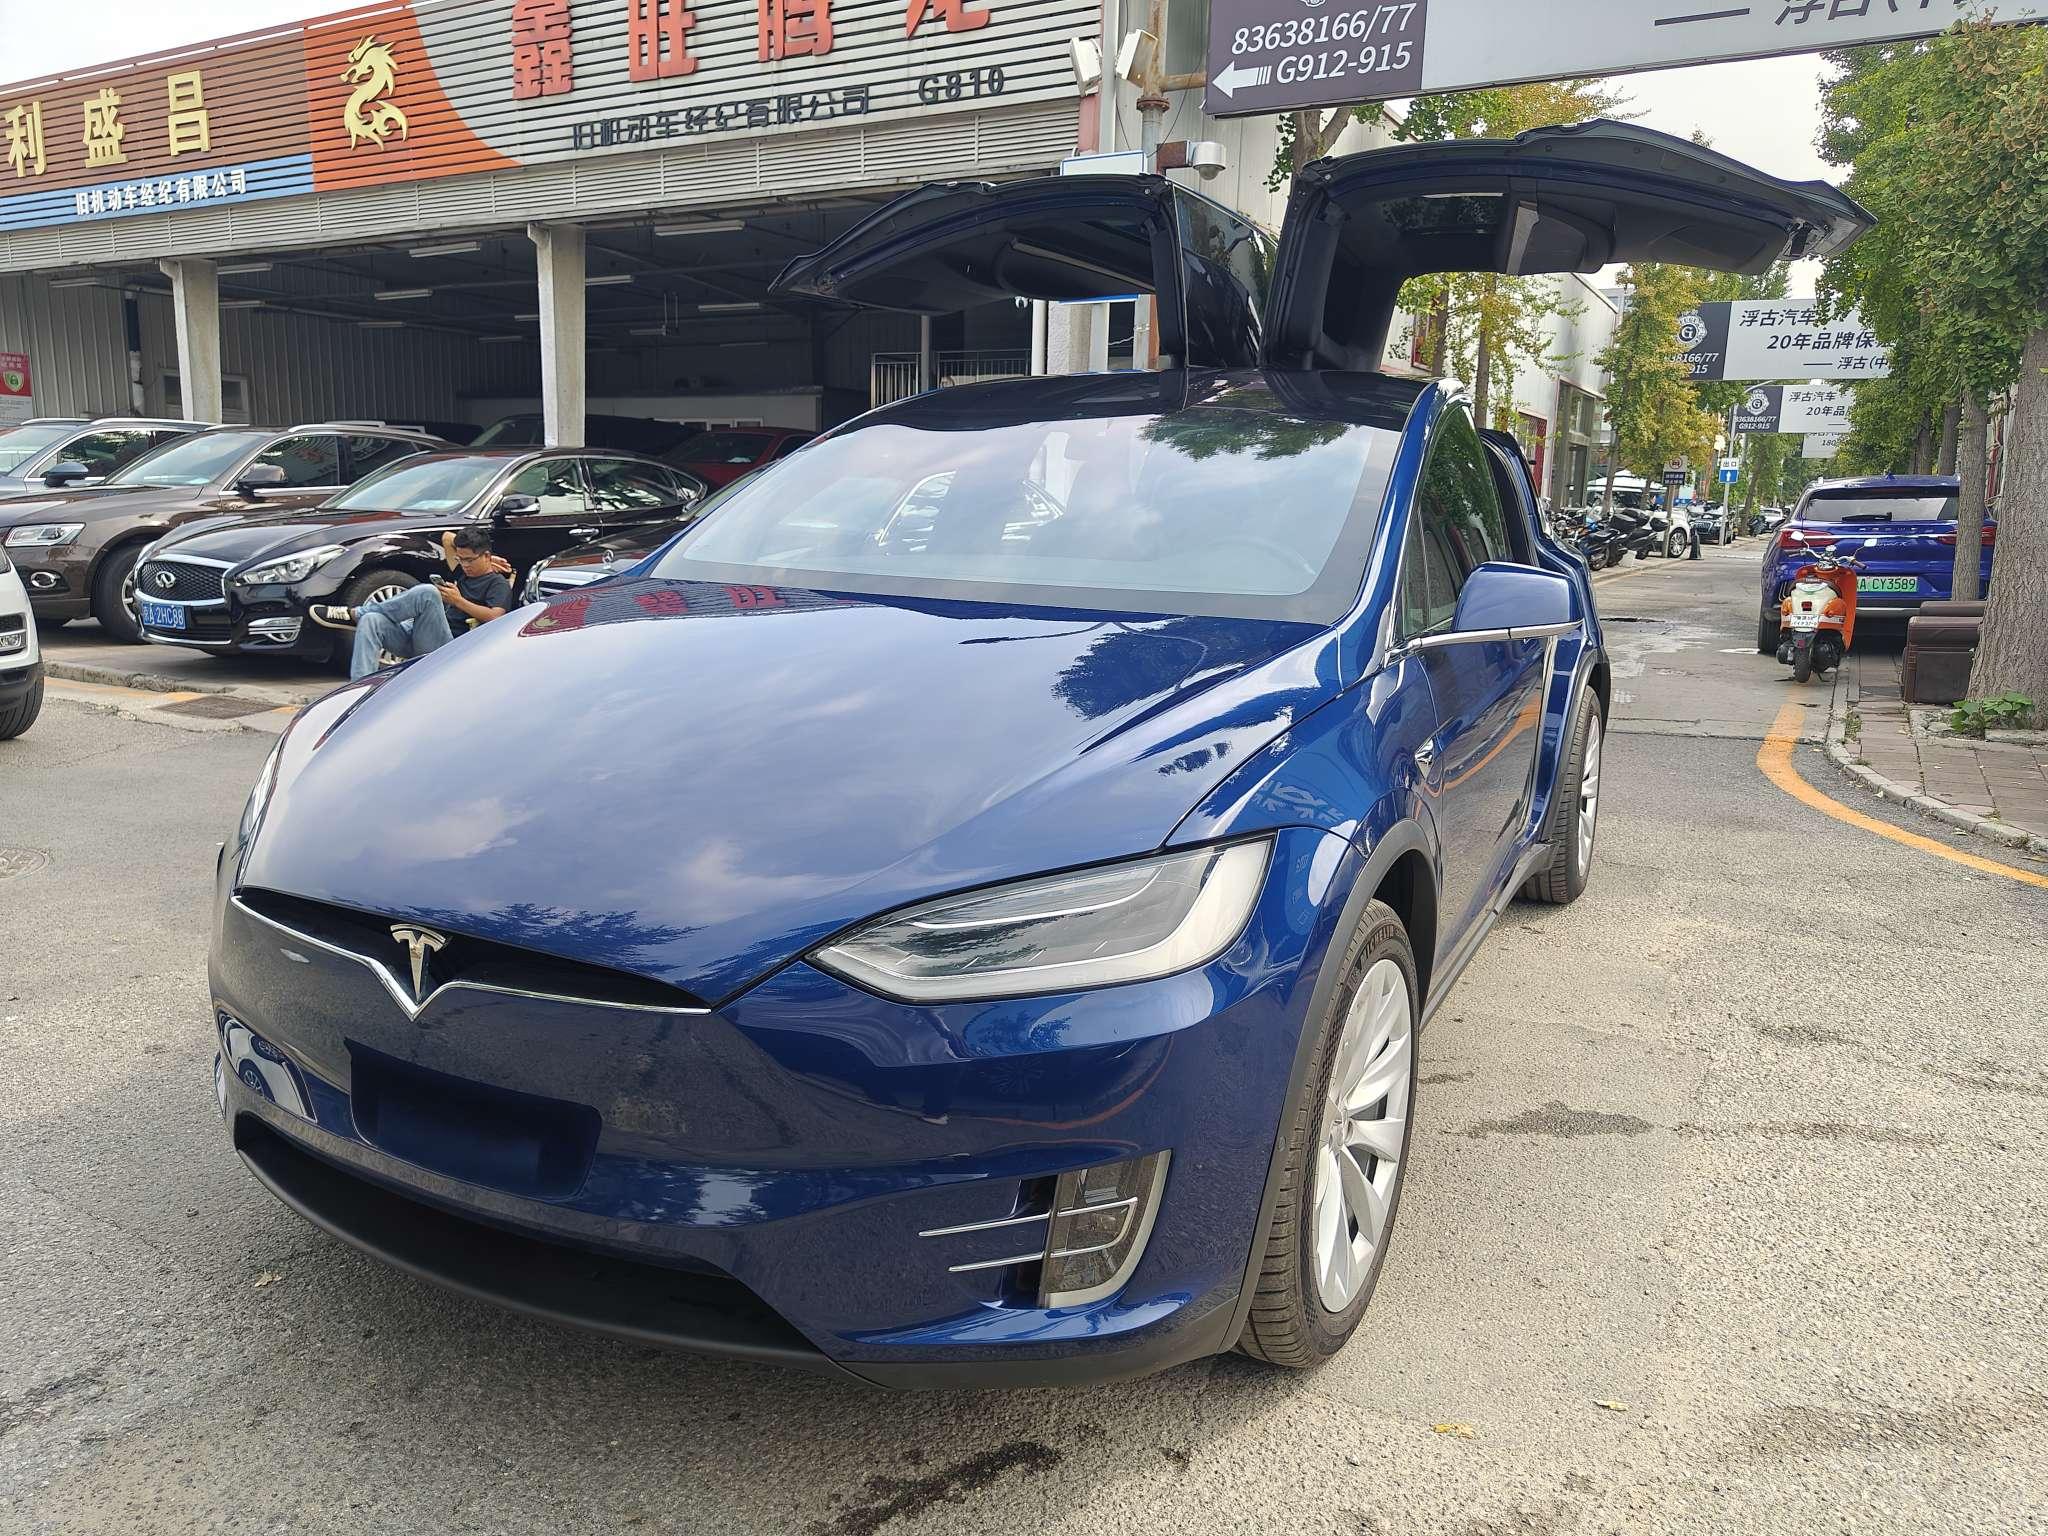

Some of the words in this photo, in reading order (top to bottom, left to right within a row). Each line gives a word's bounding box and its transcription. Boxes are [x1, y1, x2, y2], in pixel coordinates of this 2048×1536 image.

[1231, 3, 1417, 55] 83638166/77
[1276, 41, 1413, 83] G912-915
[4, 70, 211, 178] 利盛昌
[573, 85, 869, 150] 旧机动车经纪有限公司
[918, 65, 1005, 105] G810
[75, 168, 247, 216] 旧机动车经纪有限公司
[1767, 331, 1896, 351] 20年品牌保
[1788, 391, 1838, 402] 浮古汽车
[1806, 405, 1850, 417] 20年品
[1872, 578, 1917, 590] CY3589
